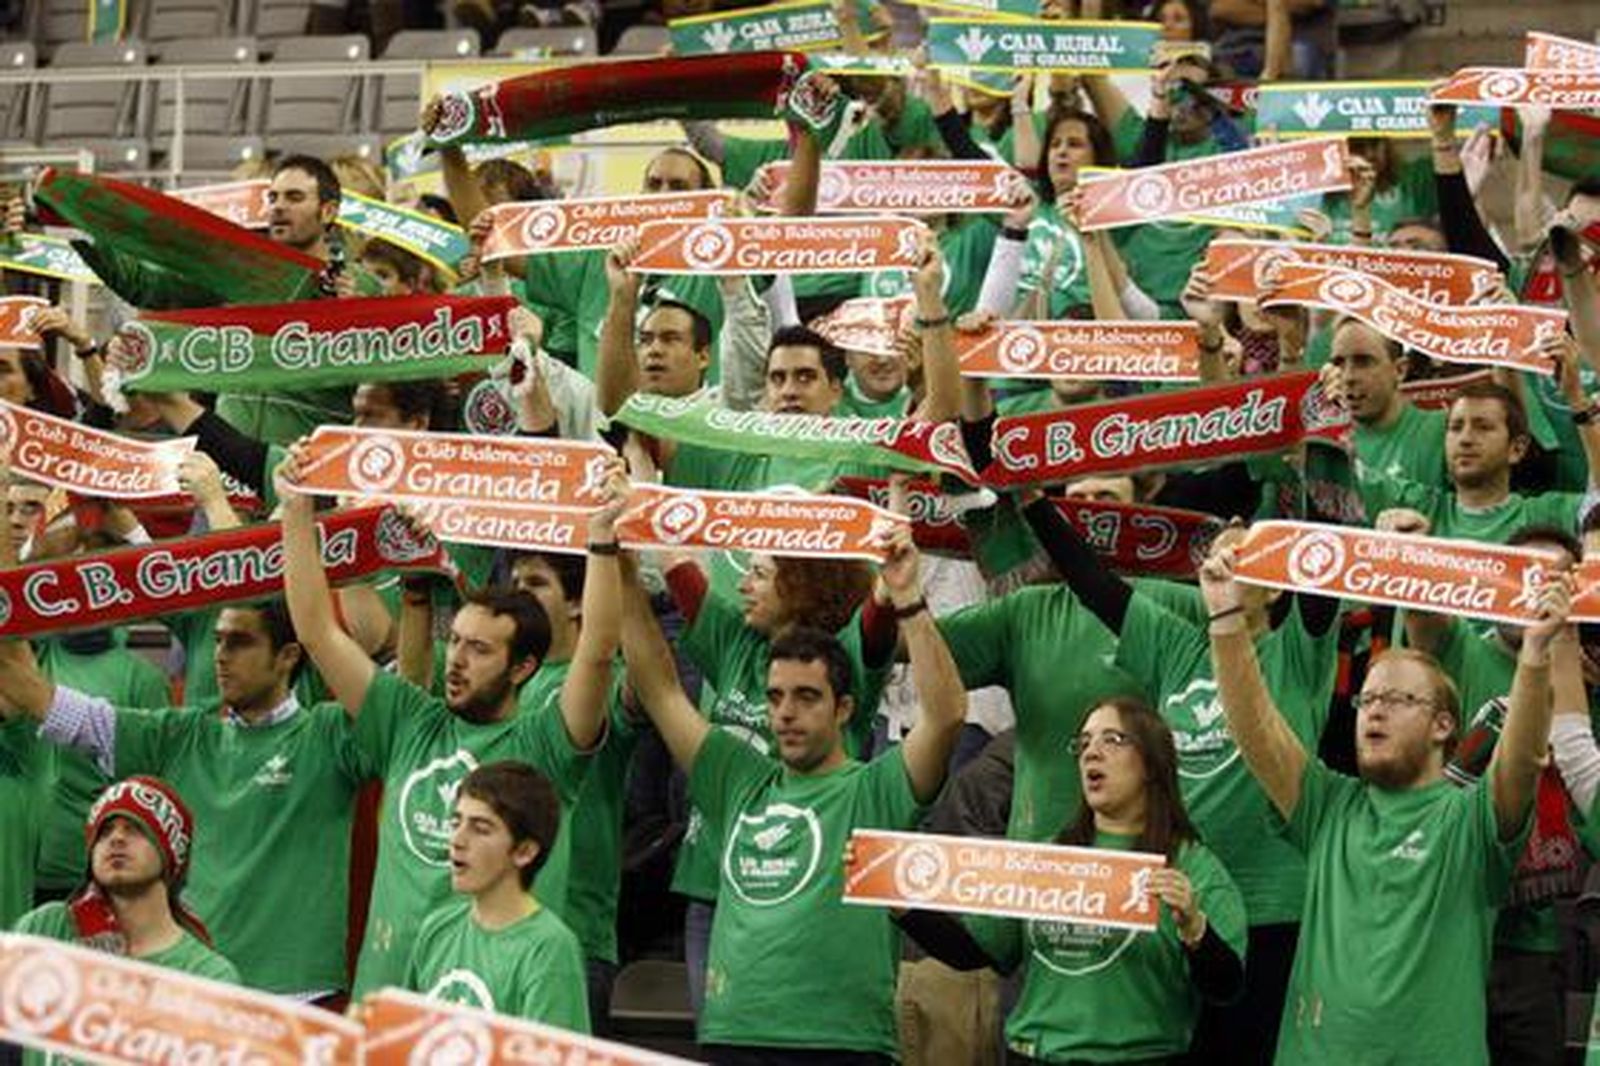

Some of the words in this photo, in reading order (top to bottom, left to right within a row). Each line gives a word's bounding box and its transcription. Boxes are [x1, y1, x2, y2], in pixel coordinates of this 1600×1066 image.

[739, 18, 784, 40] CAJA
[786, 10, 840, 33] RURA
[1000, 33, 1047, 50] CAJA
[1054, 34, 1124, 54] RURAL
[1013, 53, 1033, 67] DE
[1036, 54, 1112, 68] GRANADA
[1337, 96, 1387, 115] CAJA
[1350, 117, 1373, 130] DE
[853, 168, 883, 183] Club
[886, 168, 981, 183] Baloncesto
[1176, 161, 1217, 180] Club
[851, 183, 977, 207] Granada
[1177, 169, 1309, 207] Granada
[572, 204, 609, 218] Club
[610, 198, 696, 216] Baloncesto
[567, 222, 636, 244] Gran
[740, 226, 781, 239] Club
[784, 226, 883, 240] Baloncesto
[736, 241, 878, 267] Granada
[1355, 257, 1455, 278] Baloncesto
[1371, 305, 1511, 357] Granada
[1425, 308, 1519, 329] Baloncesto
[178, 324, 254, 374] CB
[271, 307, 483, 372] Granada
[1051, 330, 1081, 345] Club
[1083, 330, 1183, 345] Baloncesto
[1048, 347, 1179, 373] Granada
[25, 419, 67, 449] Club
[996, 425, 1036, 472] C.
[1045, 422, 1083, 463] B.
[1091, 390, 1287, 460] Granada
[413, 442, 457, 460] Club
[460, 445, 567, 467] Baloncesto
[18, 444, 154, 492] Granada
[406, 463, 561, 499] Granada
[714, 499, 753, 516] Club
[756, 501, 858, 520] Baloncesto
[442, 504, 576, 544] Granada
[702, 517, 845, 551] Granada
[23, 570, 81, 615] C.
[81, 562, 133, 608] B.
[137, 523, 358, 598] Granaa
[1353, 540, 1397, 561] Club
[1401, 547, 1507, 575] Baloncesto
[1343, 561, 1497, 609] Granada
[956, 846, 999, 869] Club
[1002, 854, 1113, 880] Baloncesto
[950, 871, 1107, 916] Granada
